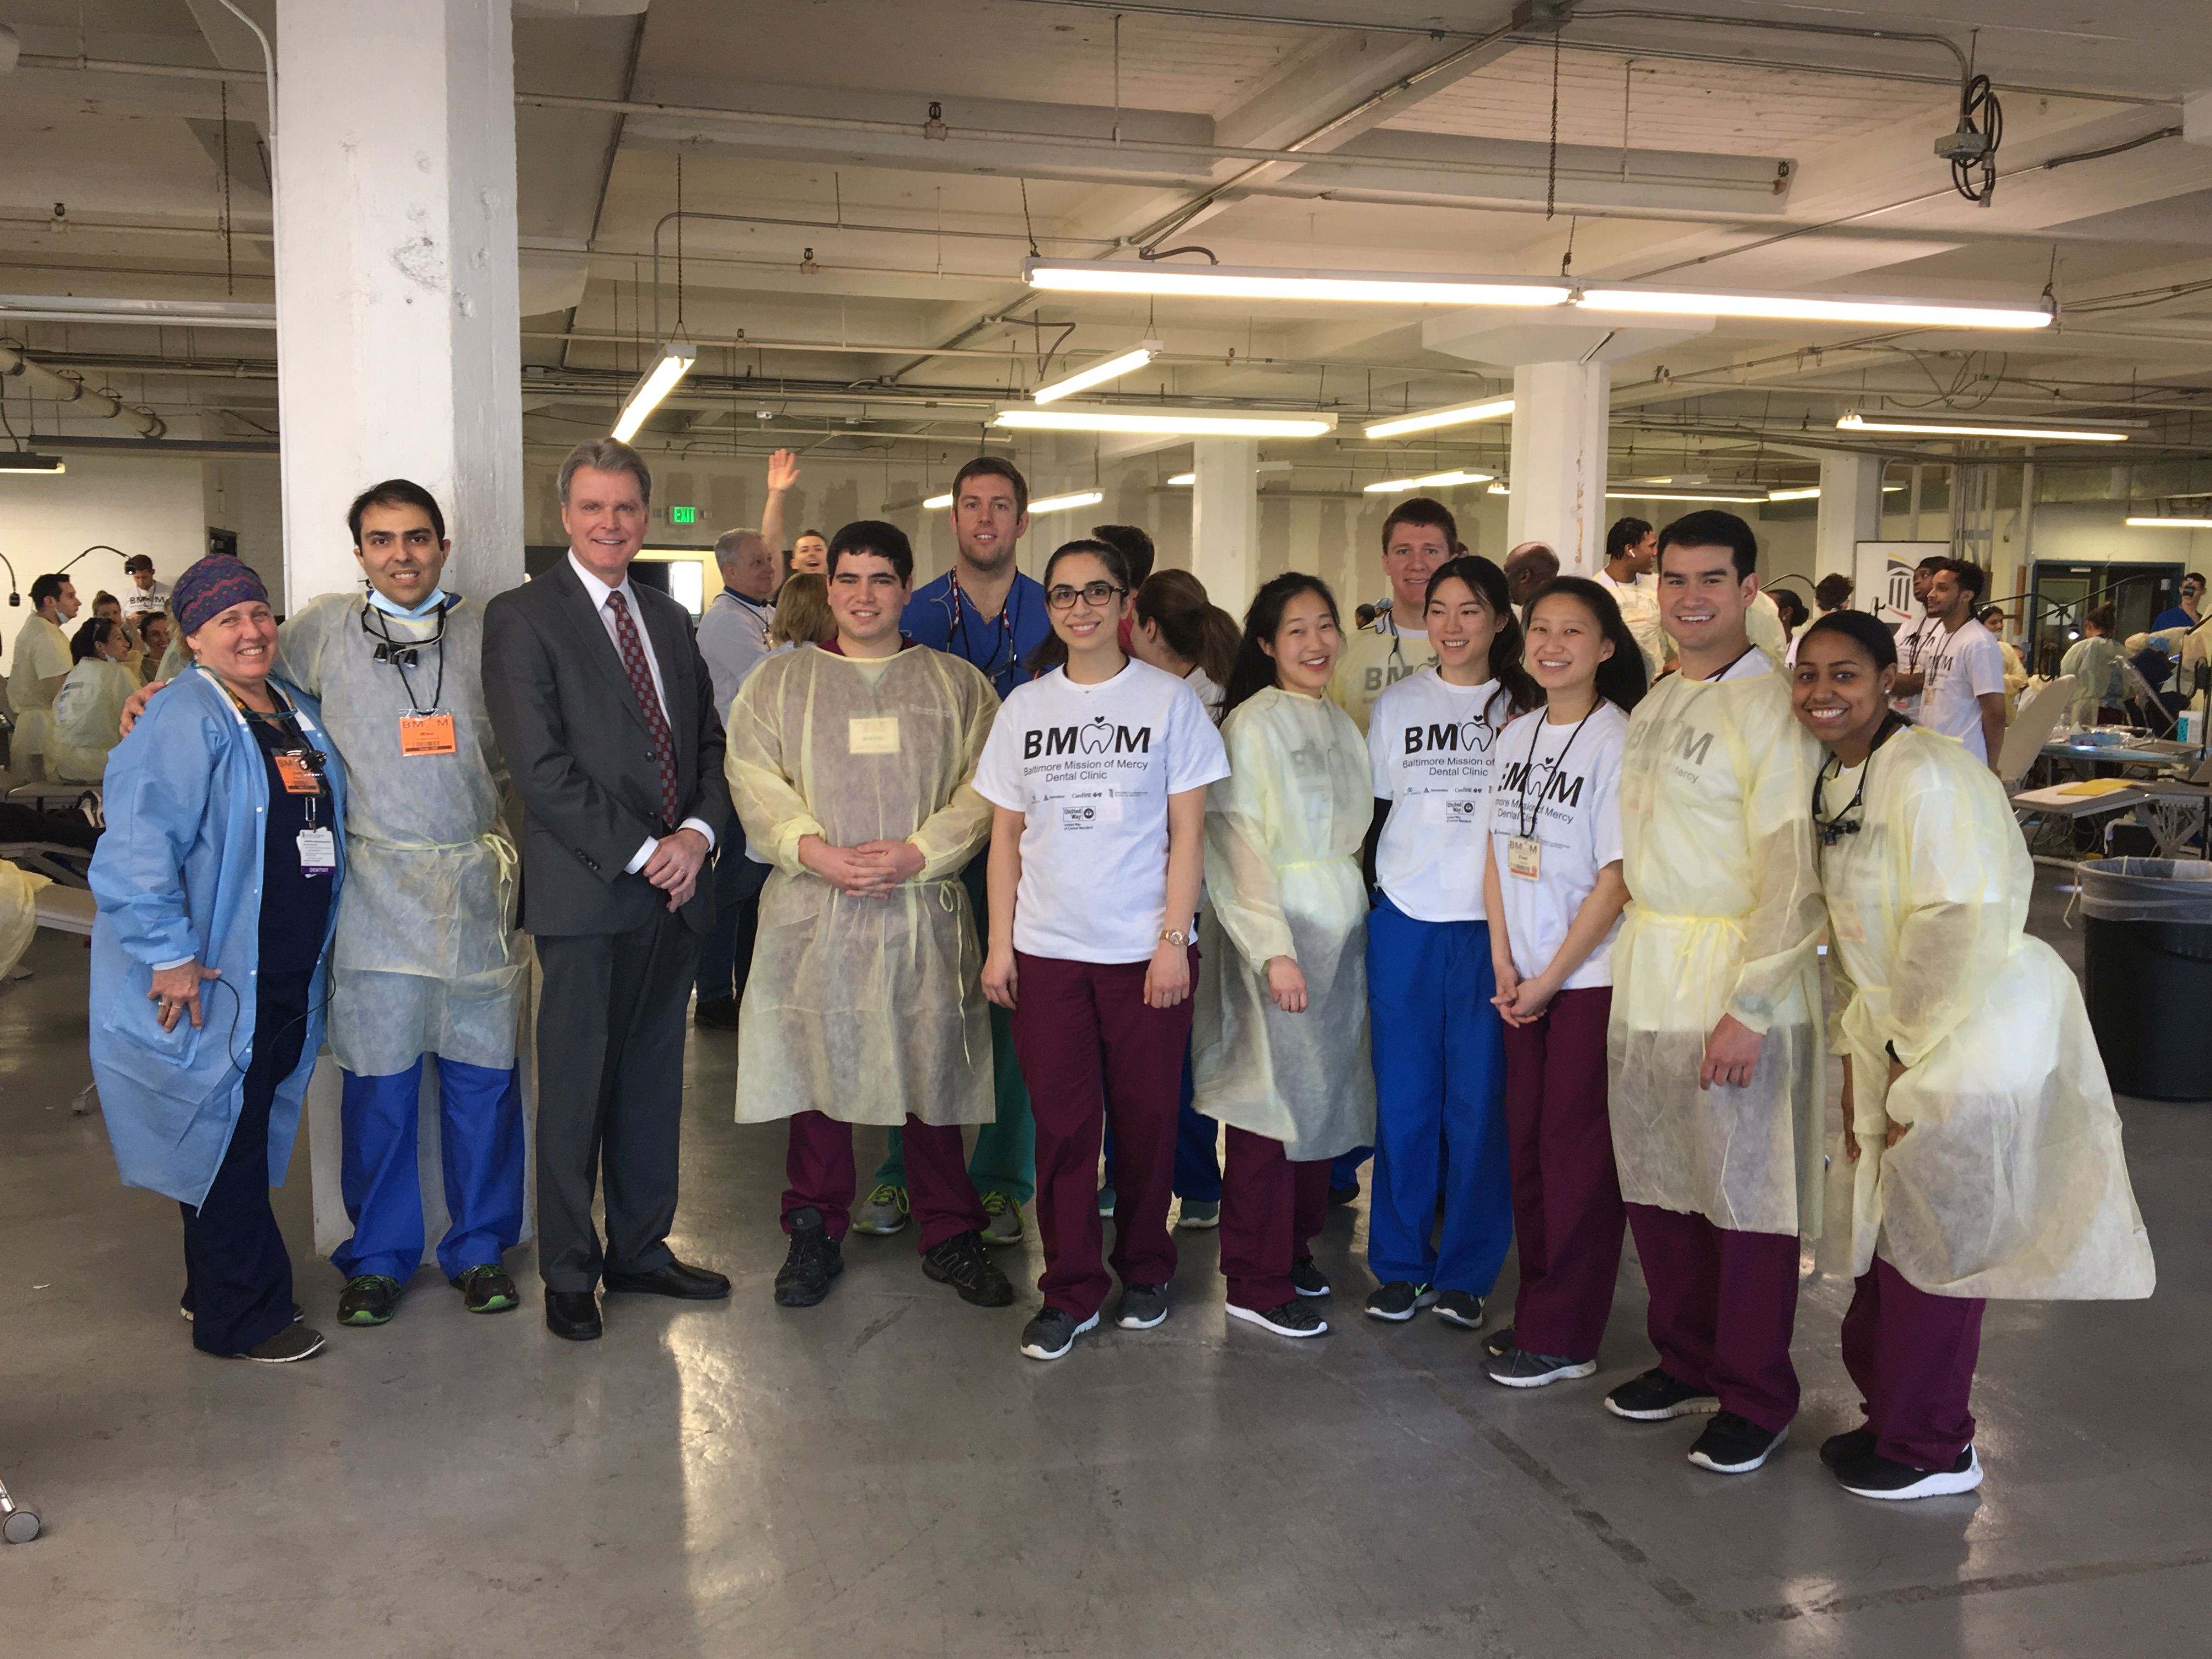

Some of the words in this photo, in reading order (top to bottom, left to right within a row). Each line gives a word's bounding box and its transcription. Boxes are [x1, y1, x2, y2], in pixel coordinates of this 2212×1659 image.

[674, 507, 695, 522] EXIT
[1024, 763, 1062, 776] Baltimore
[1065, 760, 1101, 770] Mission
[1104, 759, 1115, 768] of
[1117, 759, 1148, 771] Mercy
[1402, 758, 1444, 768] Baltimore
[1447, 757, 1482, 765] Mission
[1046, 771, 1077, 782] Dental
[1080, 770, 1107, 780] Clinic
[1429, 767, 1459, 775] Dental
[1462, 766, 1488, 776] Clinic
[1498, 808, 1520, 820] Dental
[1511, 799, 1536, 811] Mision
[1544, 806, 1574, 825] Mercy
